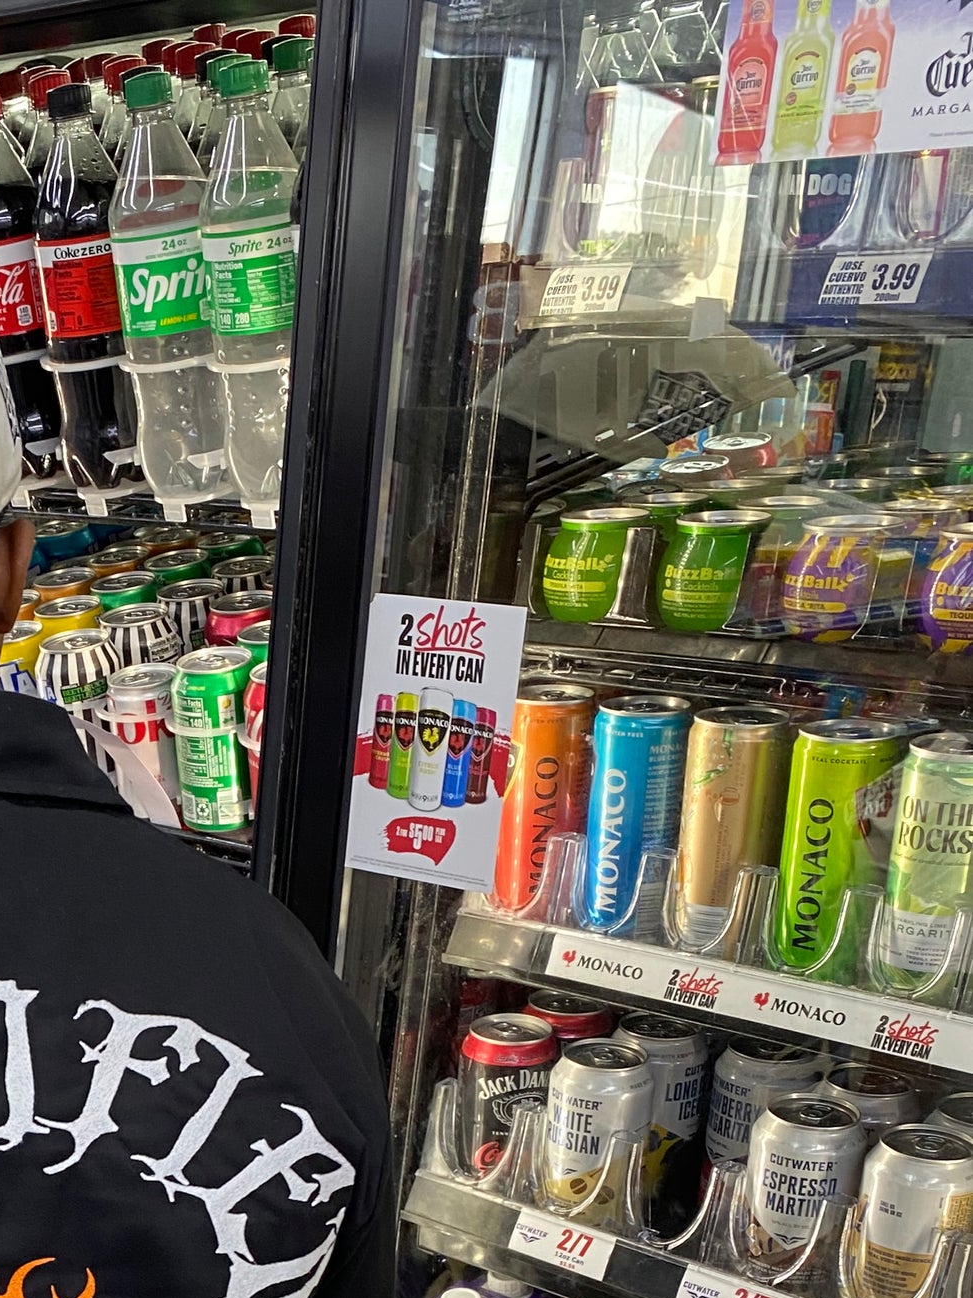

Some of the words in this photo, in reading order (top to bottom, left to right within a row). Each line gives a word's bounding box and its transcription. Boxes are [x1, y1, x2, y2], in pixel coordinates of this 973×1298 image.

[790, 70, 819, 86] Cuervo
[850, 64, 876, 78] Cuervo
[807, 173, 853, 196] DOG
[161, 239, 176, 250] 24
[228, 240, 263, 257] Sprite
[267, 237, 281, 249] 24
[829, 272, 867, 283] CUERVO
[840, 261, 864, 271] JOSE
[871, 262, 920, 290] $3.99
[547, 285, 577, 296] CUERVO
[823, 284, 864, 295] AUTHENTIC
[235, 312, 250, 325] 280
[398, 613, 414, 647] 2
[415, 605, 486, 660] shots
[396, 649, 411, 675] IN
[412, 651, 455, 680] EVERY
[455, 656, 485, 684] CAN
[830, 757, 868, 765] COCKTAIL
[903, 795, 930, 824] ON
[528, 756, 560, 895] MONACO
[898, 821, 973, 855] ROCKS
[595, 768, 627, 914] MONACO
[792, 797, 835, 952] MONACO
[577, 955, 643, 980] MONACO
[668, 969, 680, 987] 2
[679, 967, 724, 996] shots
[664, 987, 674, 1001] IN
[675, 989, 700, 1007] EVERY
[697, 995, 717, 1009] CAN
[771, 998, 846, 1026] MONACO
[875, 1015, 889, 1034] 2
[887, 1013, 939, 1045] shots
[870, 1033, 884, 1048] IN
[883, 1036, 913, 1056] EVERY
[910, 1042, 932, 1060] CAN
[478, 1073, 519, 1100] JACK
[665, 1078, 699, 1102] LONG
[770, 1153, 834, 1172] CUTWATER
[763, 1168, 838, 1197] ESPRESSO
[517, 1223, 547, 1238] CUTWATER
[556, 1228, 594, 1257] 2/7
[683, 1281, 720, 1298] CUTWATER
